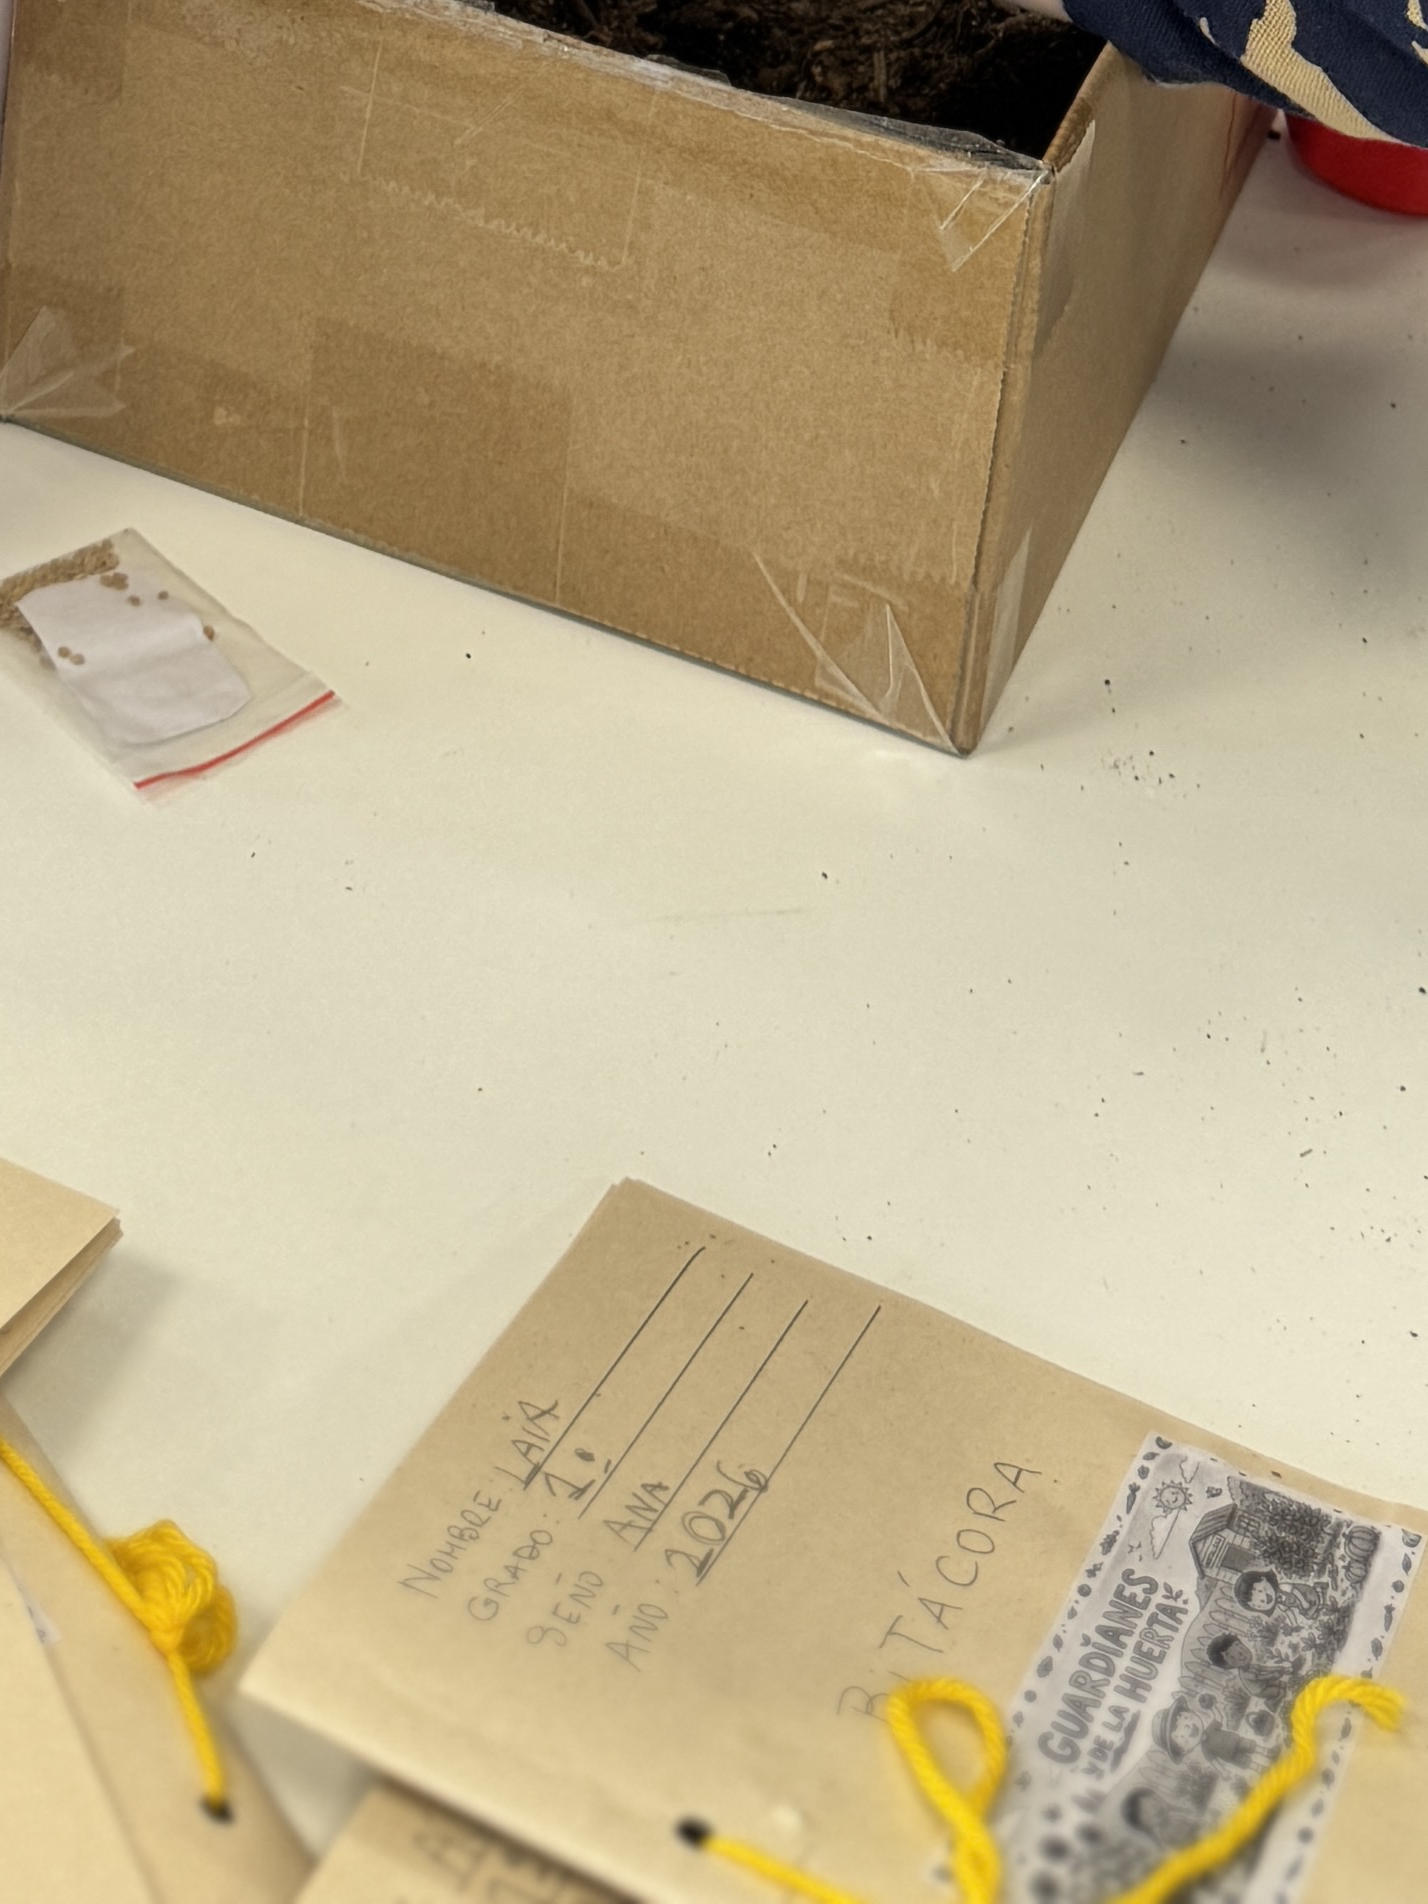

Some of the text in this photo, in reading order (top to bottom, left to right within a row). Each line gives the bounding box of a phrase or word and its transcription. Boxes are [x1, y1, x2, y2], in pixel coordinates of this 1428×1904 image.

[602, 1480, 670, 1546] ANA
[663, 1459, 769, 1578] 2026
[1036, 1567, 1160, 1765] GUARDIANES
[1113, 1602, 1190, 1704] HUERTA
[1086, 1703, 1130, 1764] DE LA
